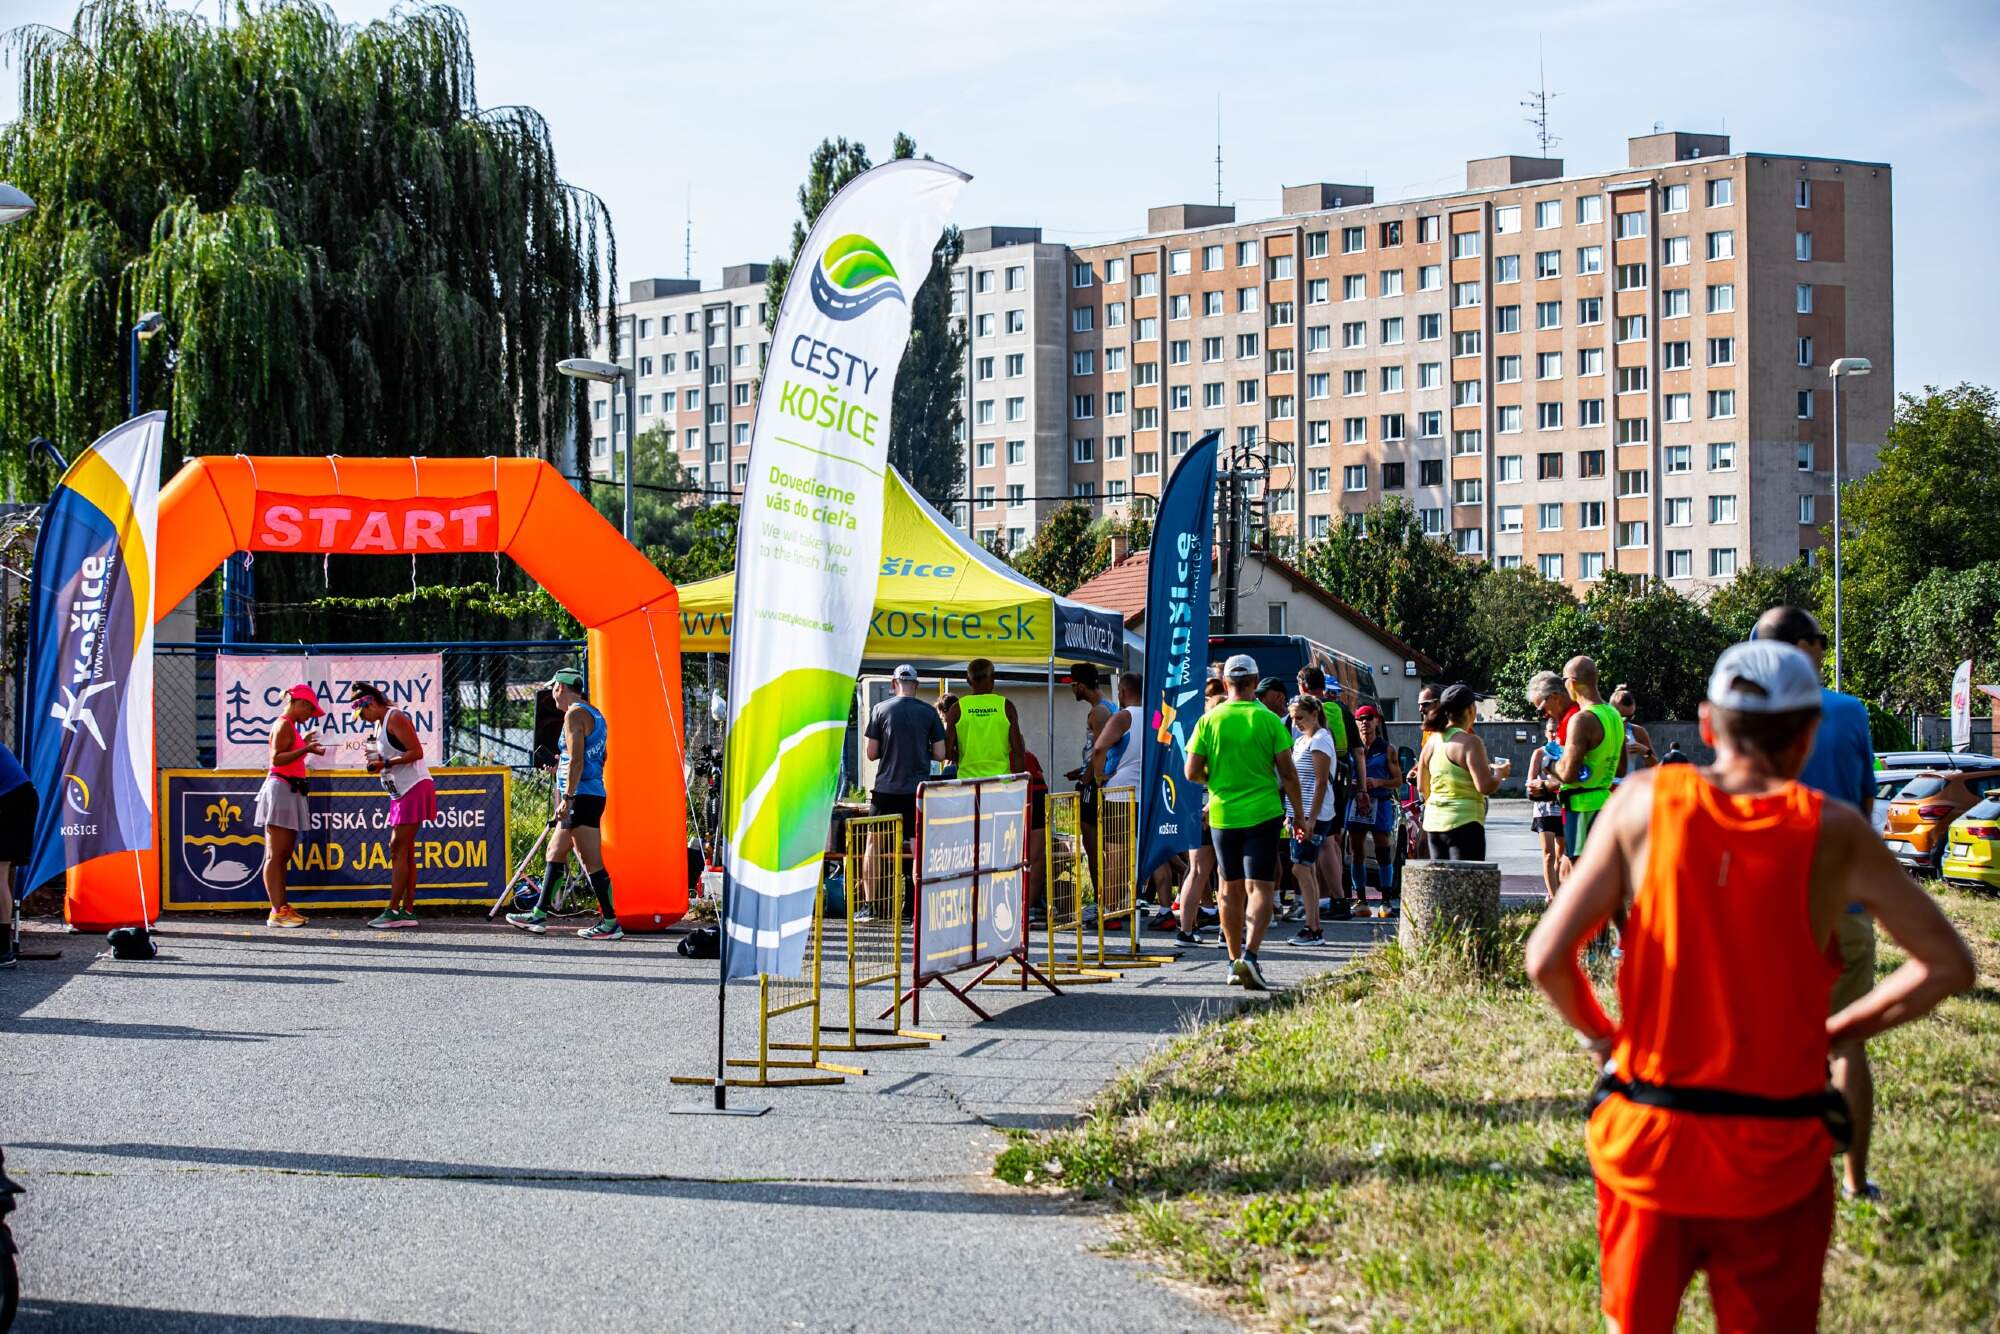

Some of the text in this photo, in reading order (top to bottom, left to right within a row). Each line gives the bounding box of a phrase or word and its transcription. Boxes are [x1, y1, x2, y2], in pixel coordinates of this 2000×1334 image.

[791, 334, 878, 395] CESTY
[779, 380, 879, 447] KOŠICE
[769, 465, 856, 505] Dovedieme
[766, 492, 790, 512] vás
[793, 499, 809, 518] do
[260, 505, 493, 551] START
[762, 522, 780, 539] We
[826, 540, 853, 557] you
[824, 556, 849, 577] line
[880, 556, 956, 578] šice
[60, 823, 98, 836] KOŠICE
[309, 807, 367, 831] STSKÁ
[287, 839, 488, 871] NAD JAEROM
